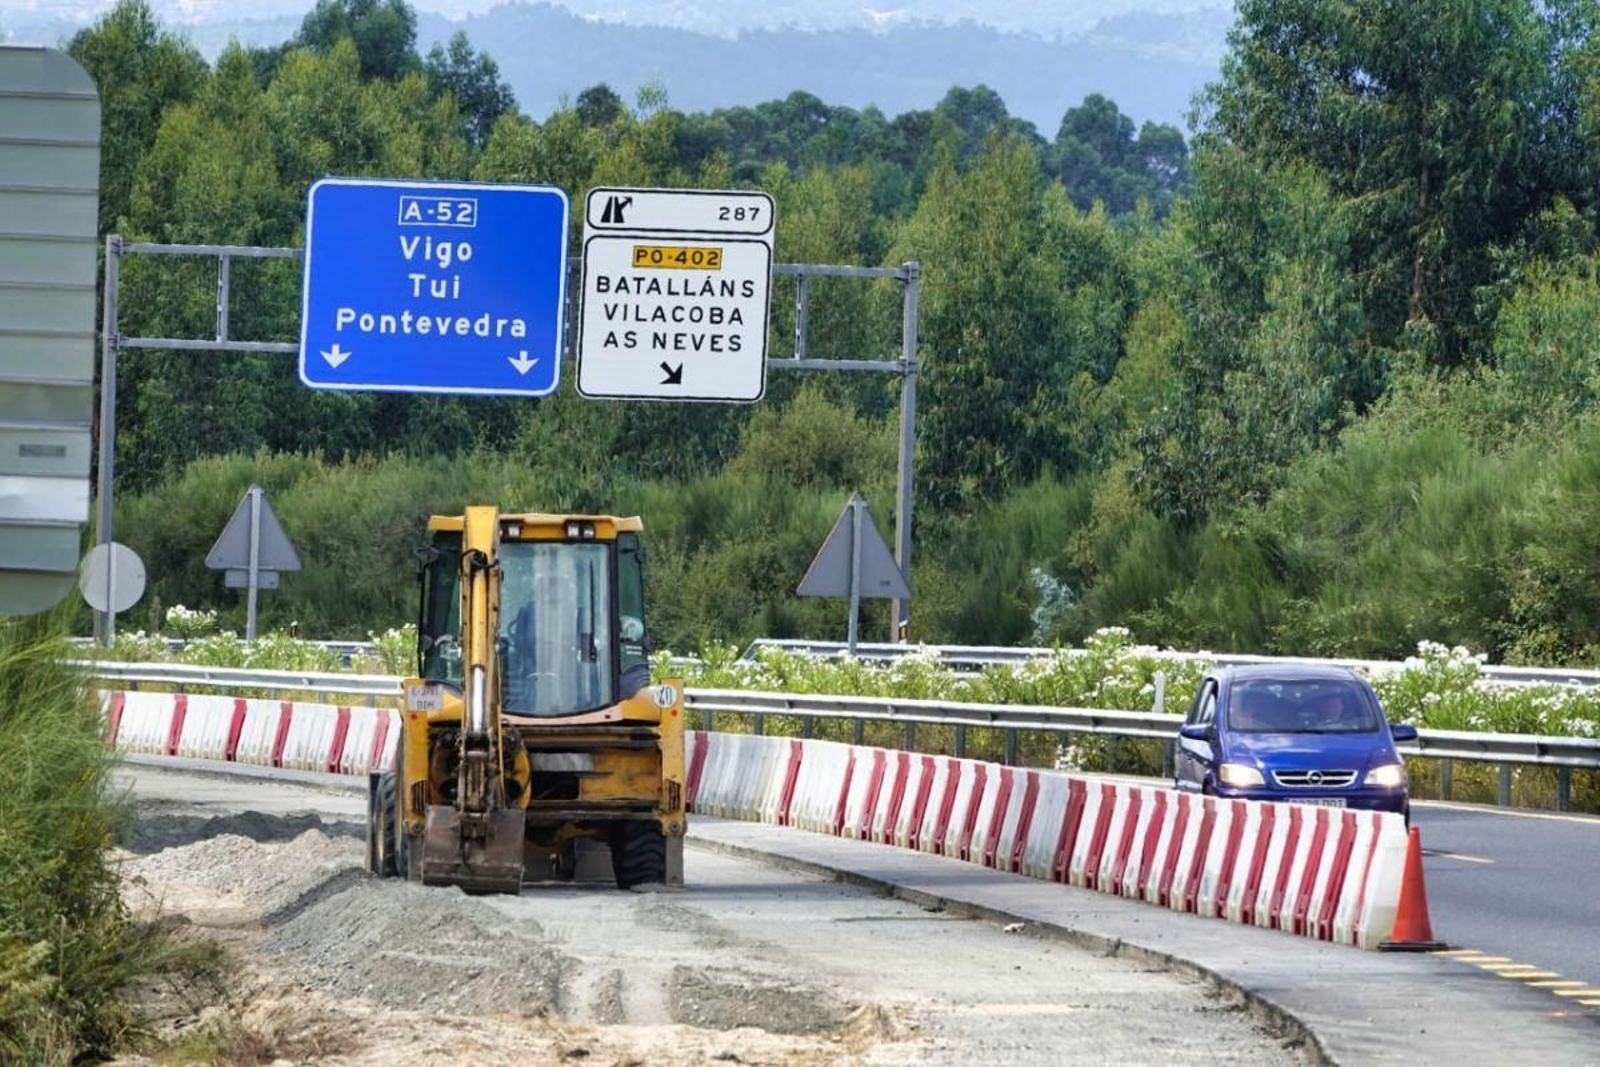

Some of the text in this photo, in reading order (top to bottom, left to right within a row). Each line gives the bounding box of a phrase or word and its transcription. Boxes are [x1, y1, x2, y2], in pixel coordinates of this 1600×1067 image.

[403, 201, 473, 223] A-52
[718, 206, 761, 221] 287
[400, 235, 473, 269] Vigo
[635, 249, 719, 266] PO-402
[408, 272, 460, 299] Tui
[596, 275, 755, 298] BATALLÁNS
[336, 308, 527, 338] Pontevedra
[603, 303, 744, 326] VILACOBA
[603, 330, 742, 352] AS NEVES
